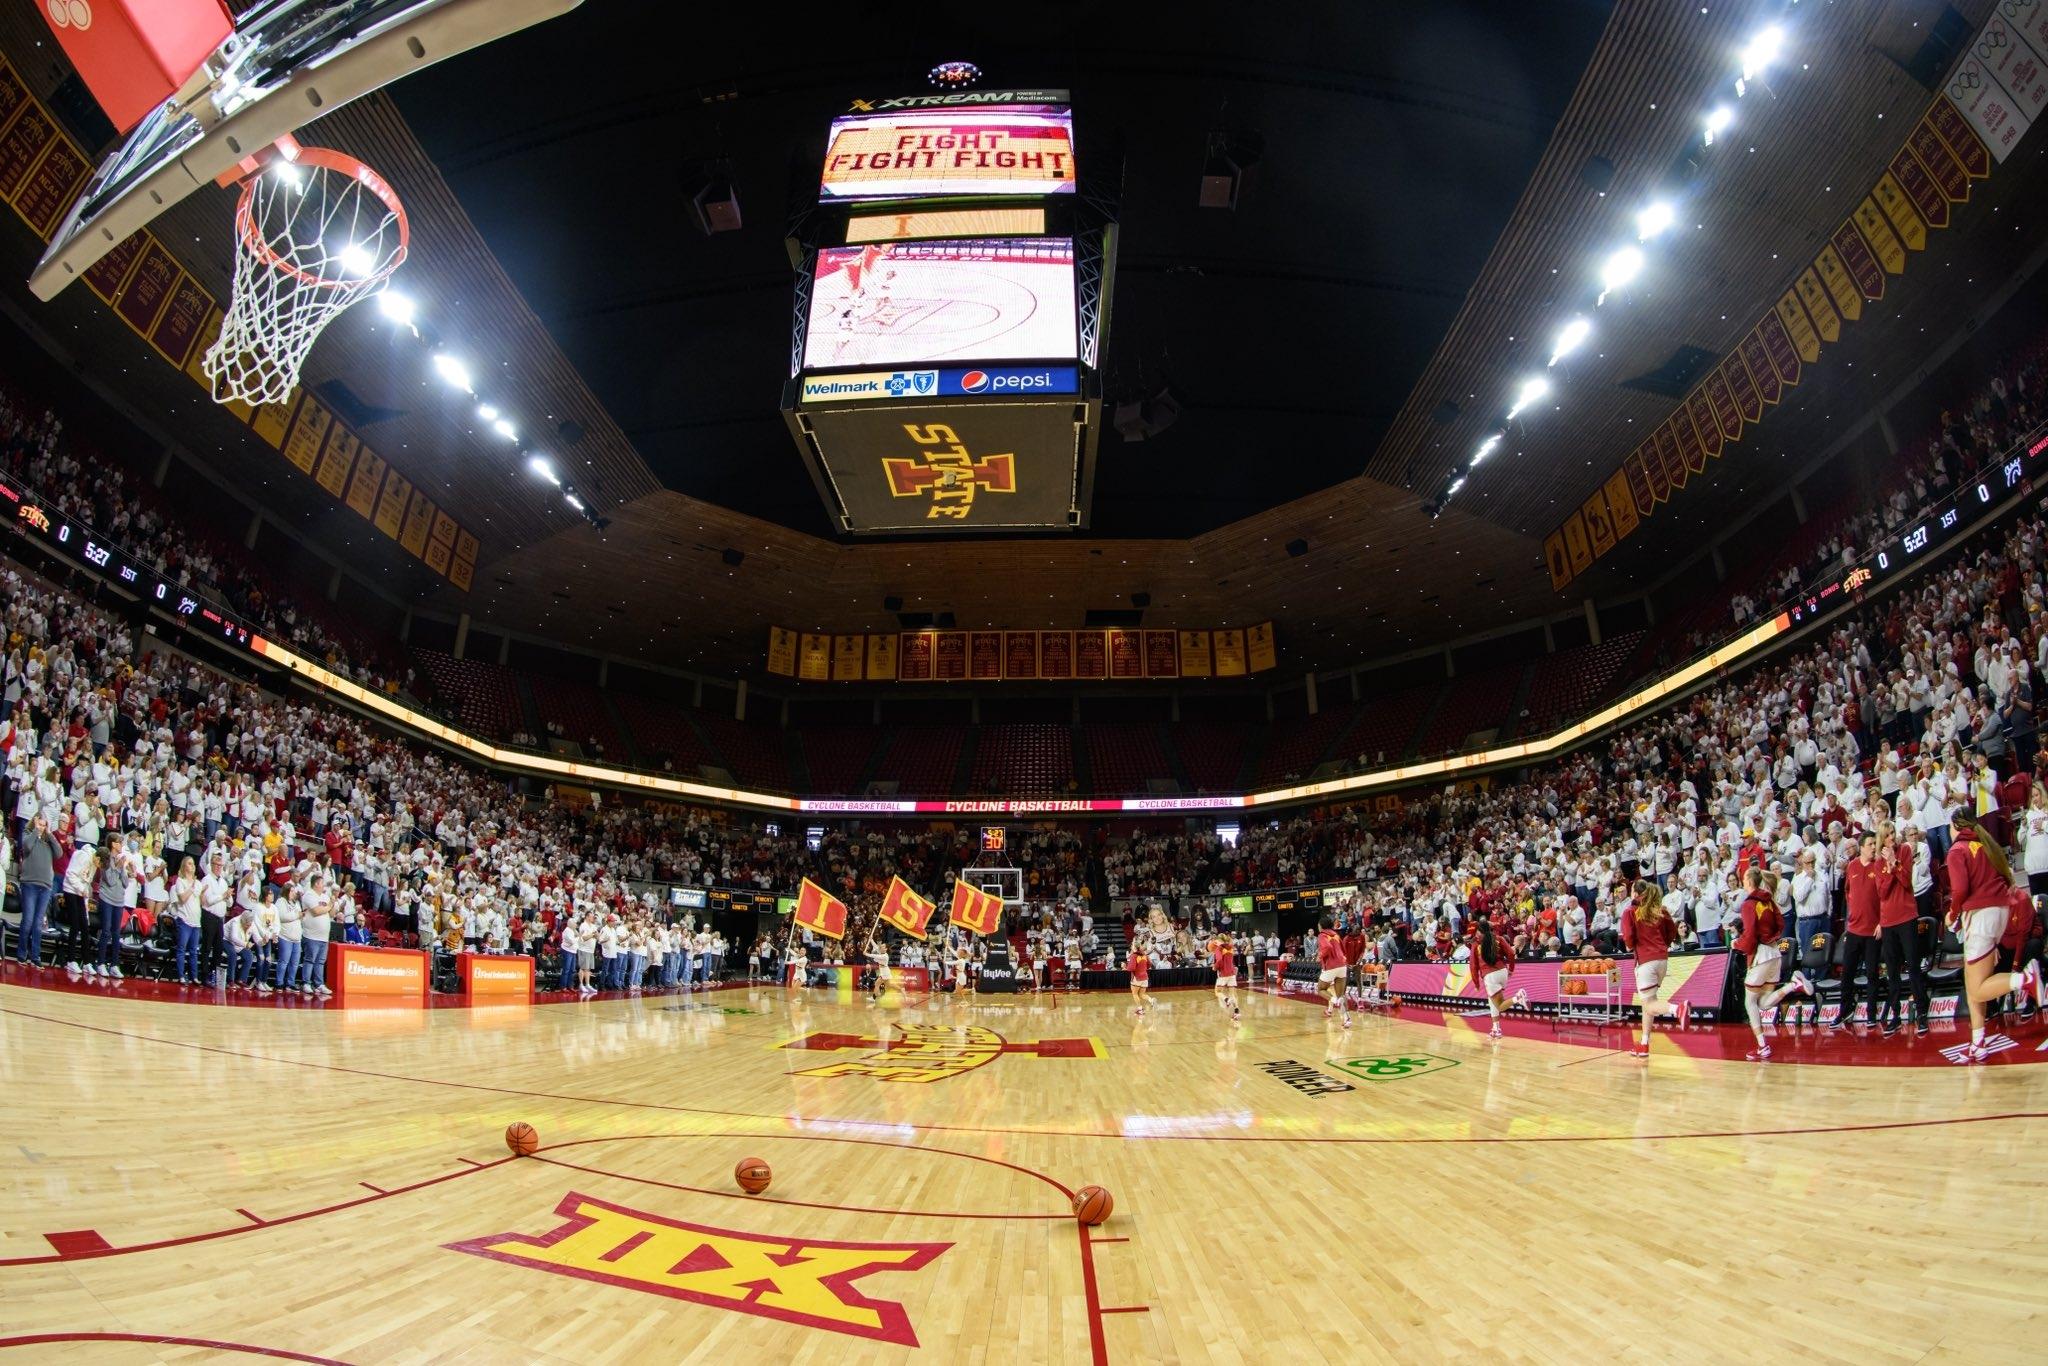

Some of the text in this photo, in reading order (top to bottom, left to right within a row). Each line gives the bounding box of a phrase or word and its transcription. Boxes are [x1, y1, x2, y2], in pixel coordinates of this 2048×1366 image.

[879, 92, 1013, 109] XTREAM
[896, 134, 1003, 150] FIGHT
[829, 151, 1066, 171] FIGHT FIGHT
[804, 380, 878, 396] Wellmark
[992, 372, 1052, 390] pepsi
[904, 424, 975, 519] STATE
[1978, 484, 1990, 502] 0
[19, 505, 50, 533] STATE
[1941, 509, 1957, 529] 1ST
[59, 525, 70, 542] 0
[1903, 526, 1928, 553] 5:27
[85, 541, 110, 567] 5:27
[1878, 552, 1888, 569] 0
[121, 565, 138, 582] 1ST
[1843, 568, 1872, 594] STATE
[156, 583, 166, 599] 0
[1820, 583, 1840, 599] BONUS
[1806, 597, 1817, 607] FLS
[1811, 604, 1817, 613] 0
[807, 801, 900, 811] CYCLONE BASKETBALL
[945, 801, 1094, 812] CYCLONE BASKETBALL
[1138, 798, 1233, 808] CYCLONE BASKETBALL
[986, 838, 1001, 849] 30
[812, 892, 832, 929] I
[892, 889, 923, 930] S
[961, 888, 992, 928] U
[358, 966, 373, 975] First
[373, 967, 406, 977] Interstate
[492, 972, 516, 980] Interstate
[1254, 1059, 1357, 1098] PIONEER
